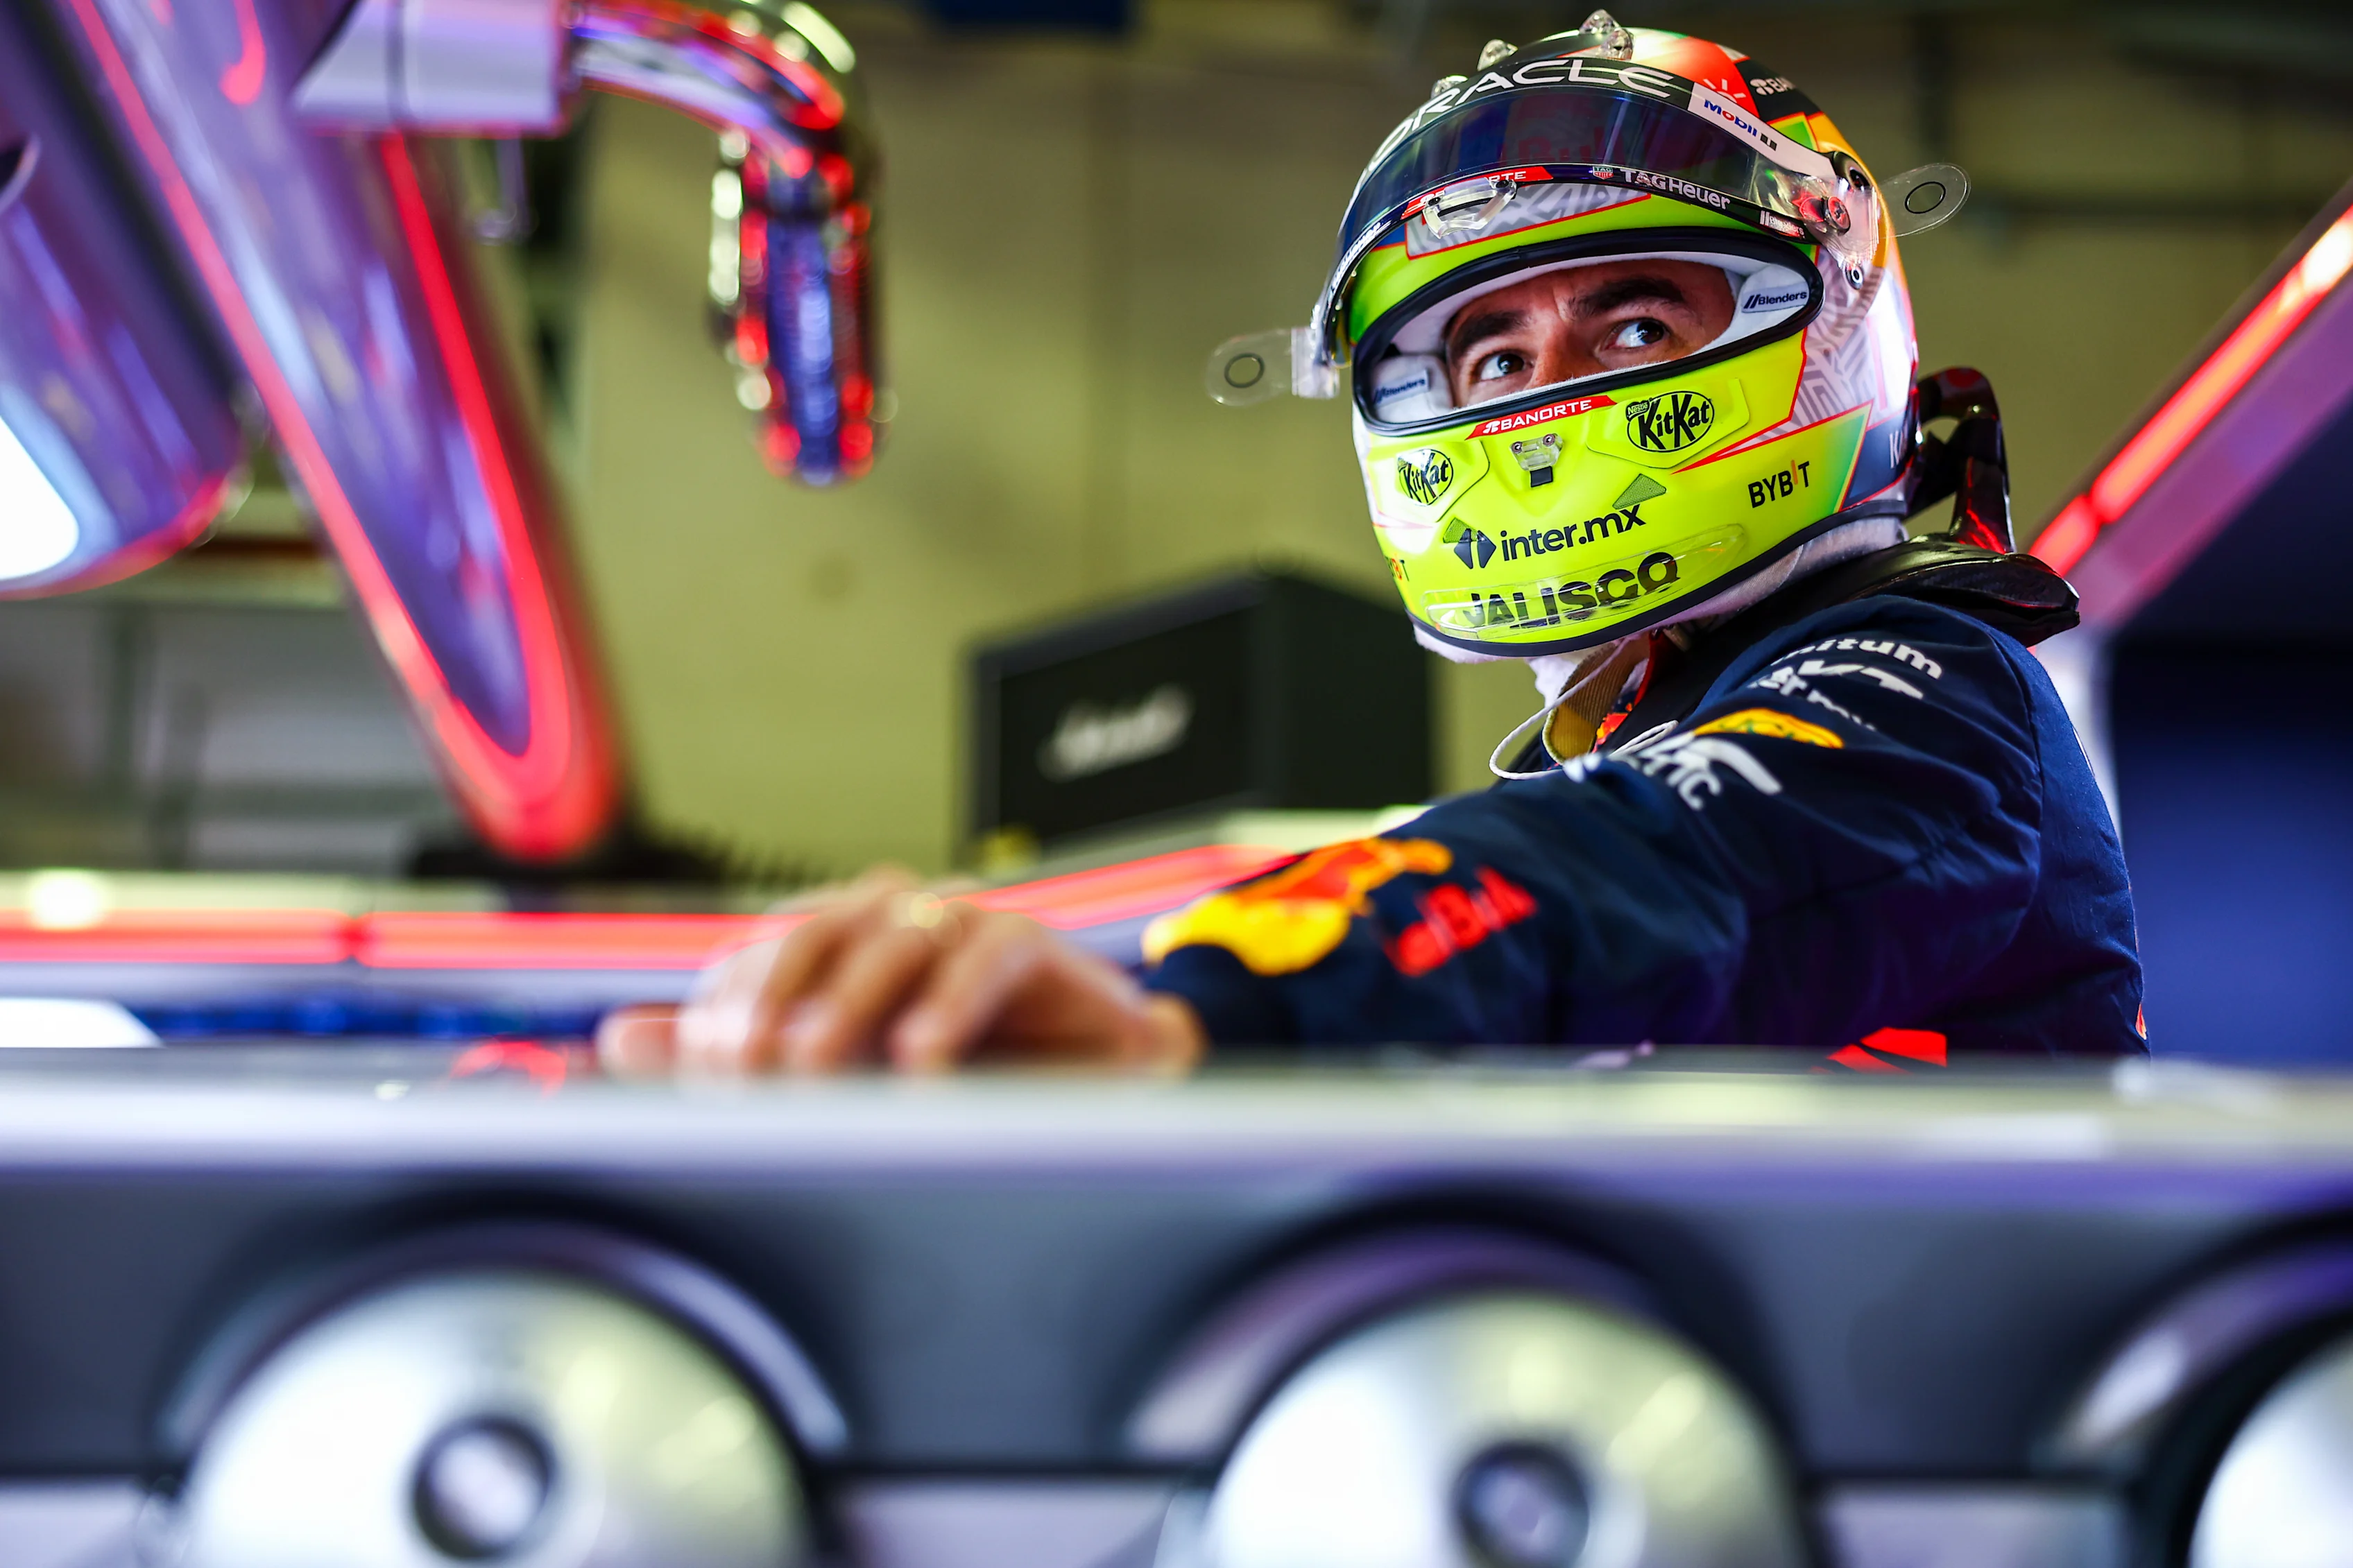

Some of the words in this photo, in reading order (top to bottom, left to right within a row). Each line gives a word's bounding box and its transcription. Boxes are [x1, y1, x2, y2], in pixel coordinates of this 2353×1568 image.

[1368, 59, 1673, 172] ORACLE
[1704, 98, 1757, 130] Mobil
[1758, 291, 1807, 305] Blenders
[1500, 399, 1592, 431] BANORTE
[1638, 393, 1709, 450] KitKat
[1403, 452, 1448, 503] KitKat
[1748, 460, 1810, 508] BYBIT
[1500, 503, 1647, 562] inter.mx
[1462, 551, 1681, 629] JALISCO
